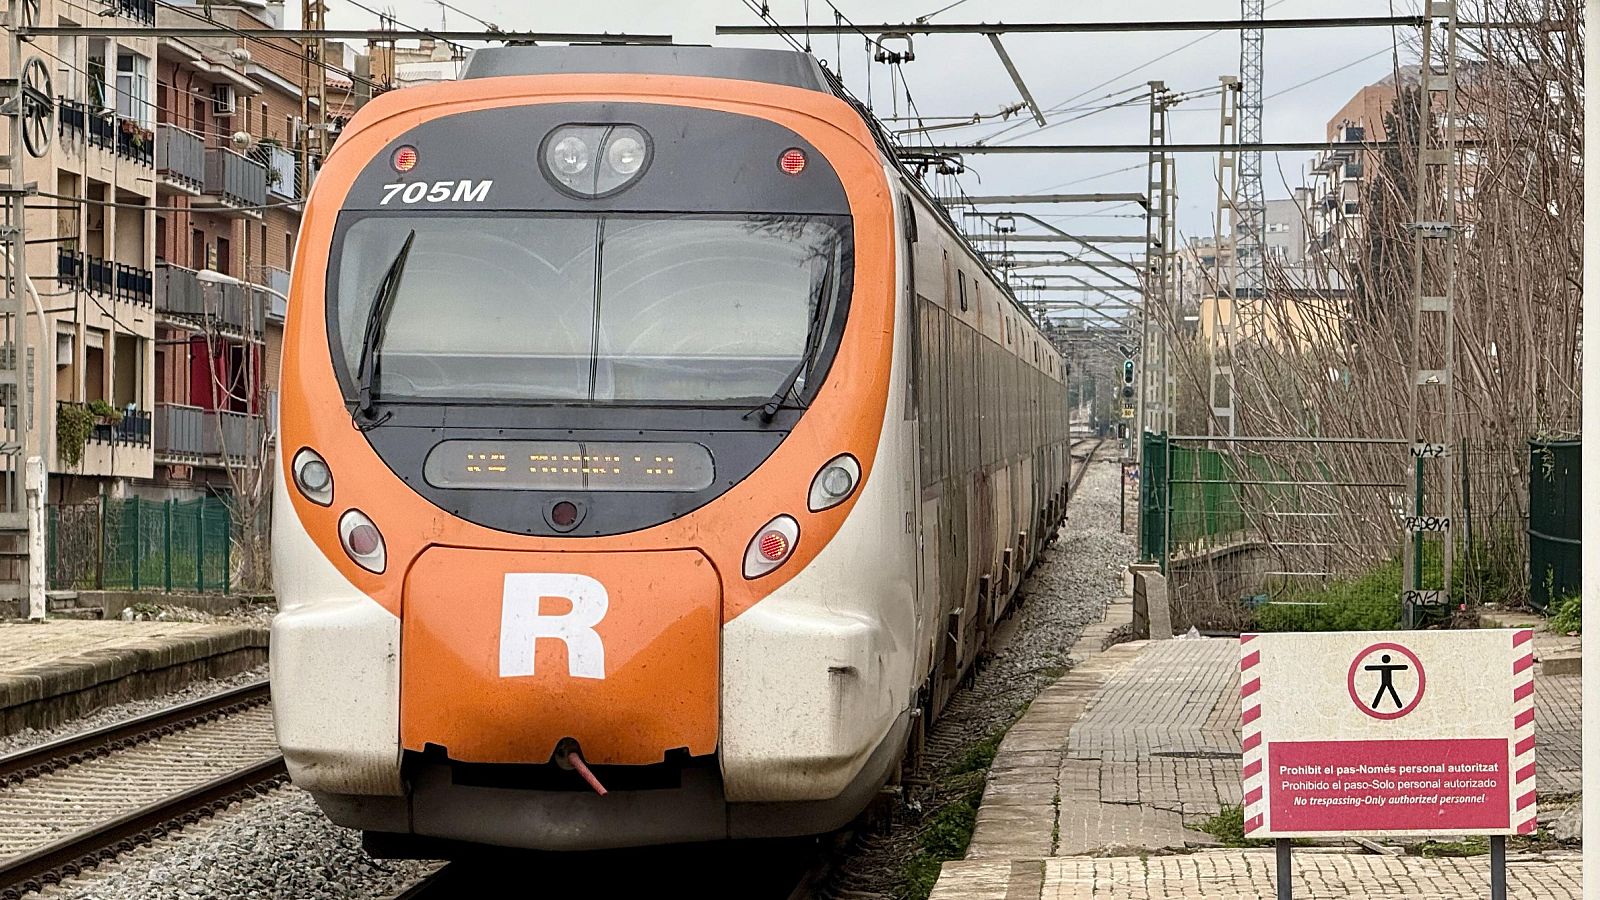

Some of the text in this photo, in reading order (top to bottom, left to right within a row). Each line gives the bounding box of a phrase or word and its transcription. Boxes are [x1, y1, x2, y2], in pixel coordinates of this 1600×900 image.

[380, 179, 493, 205] 705M
[499, 573, 609, 680] R
[1279, 762, 1499, 776] Prohibit el pas-Només personal autoritzat
[1281, 778, 1497, 791] Prohibido el paso-Solo personal autorizado
[1294, 793, 1486, 807] No trespassing-Only authorized personnel
